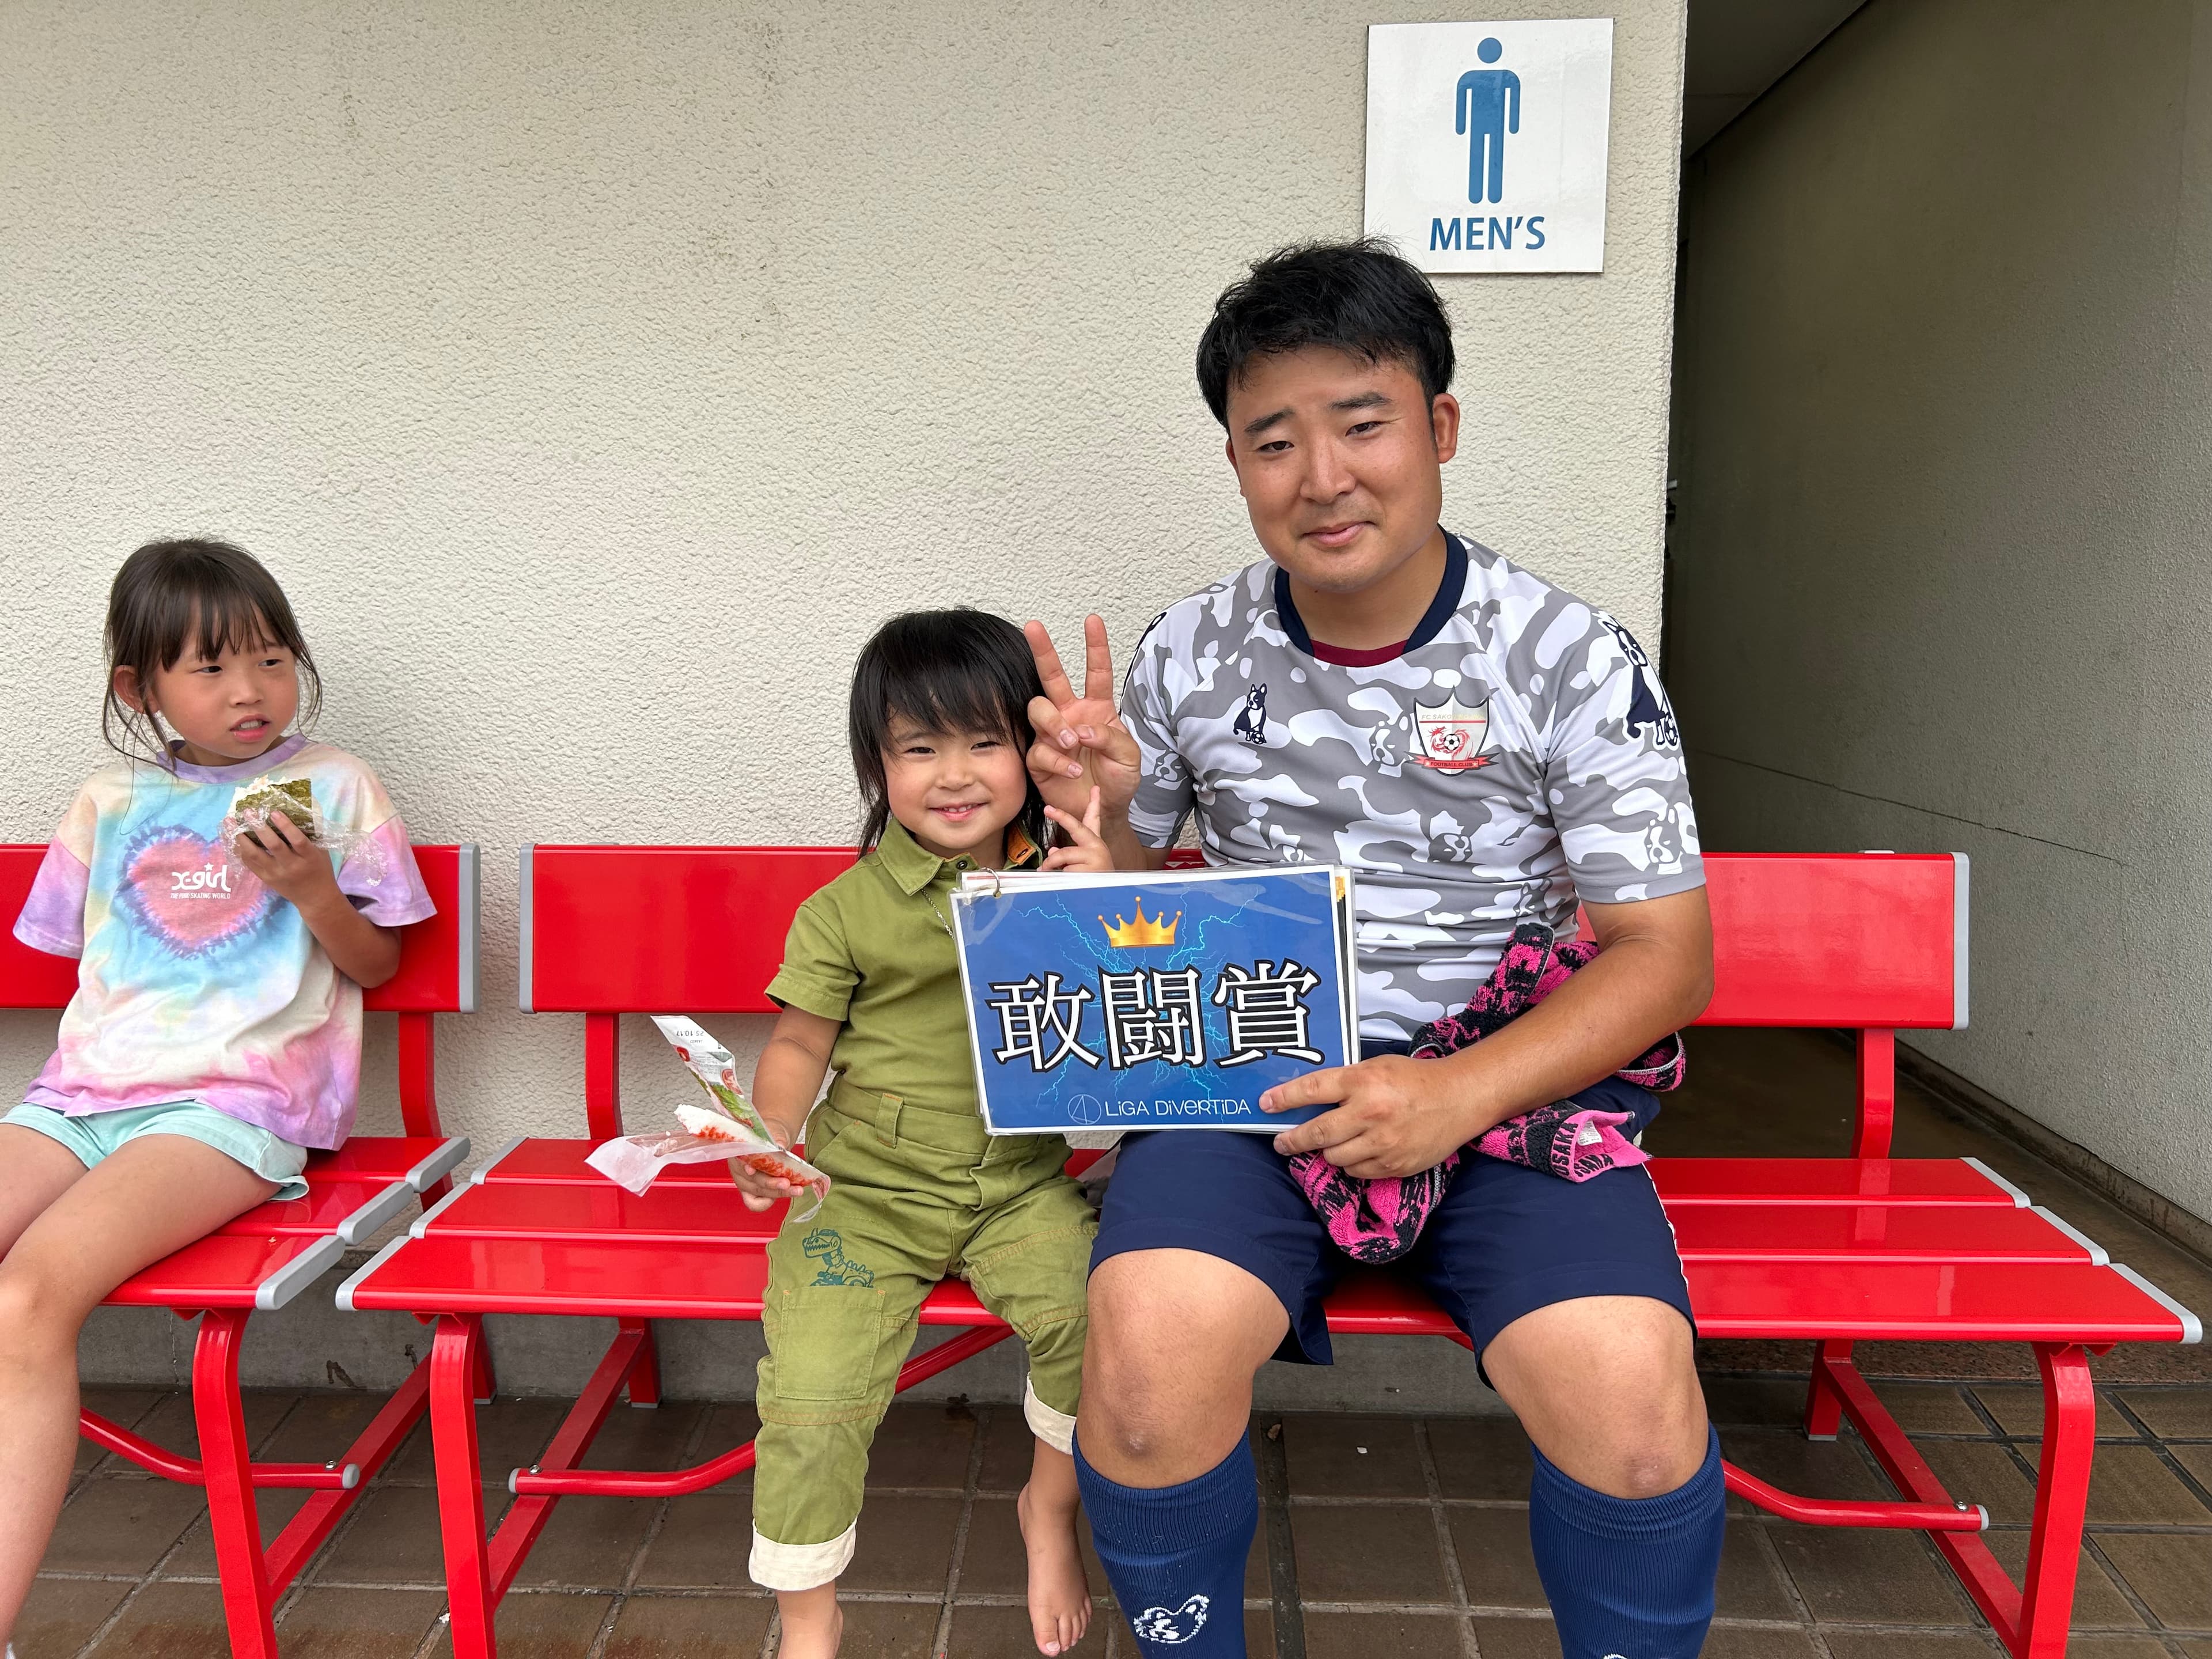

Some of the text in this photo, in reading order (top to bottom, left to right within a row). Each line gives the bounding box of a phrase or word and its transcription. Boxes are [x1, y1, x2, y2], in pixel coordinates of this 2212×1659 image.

[1430, 216, 1546, 251] MEN'S
[986, 957, 1326, 1073] 敢闘賞
[1552, 1122, 1578, 1176] OSAKA
